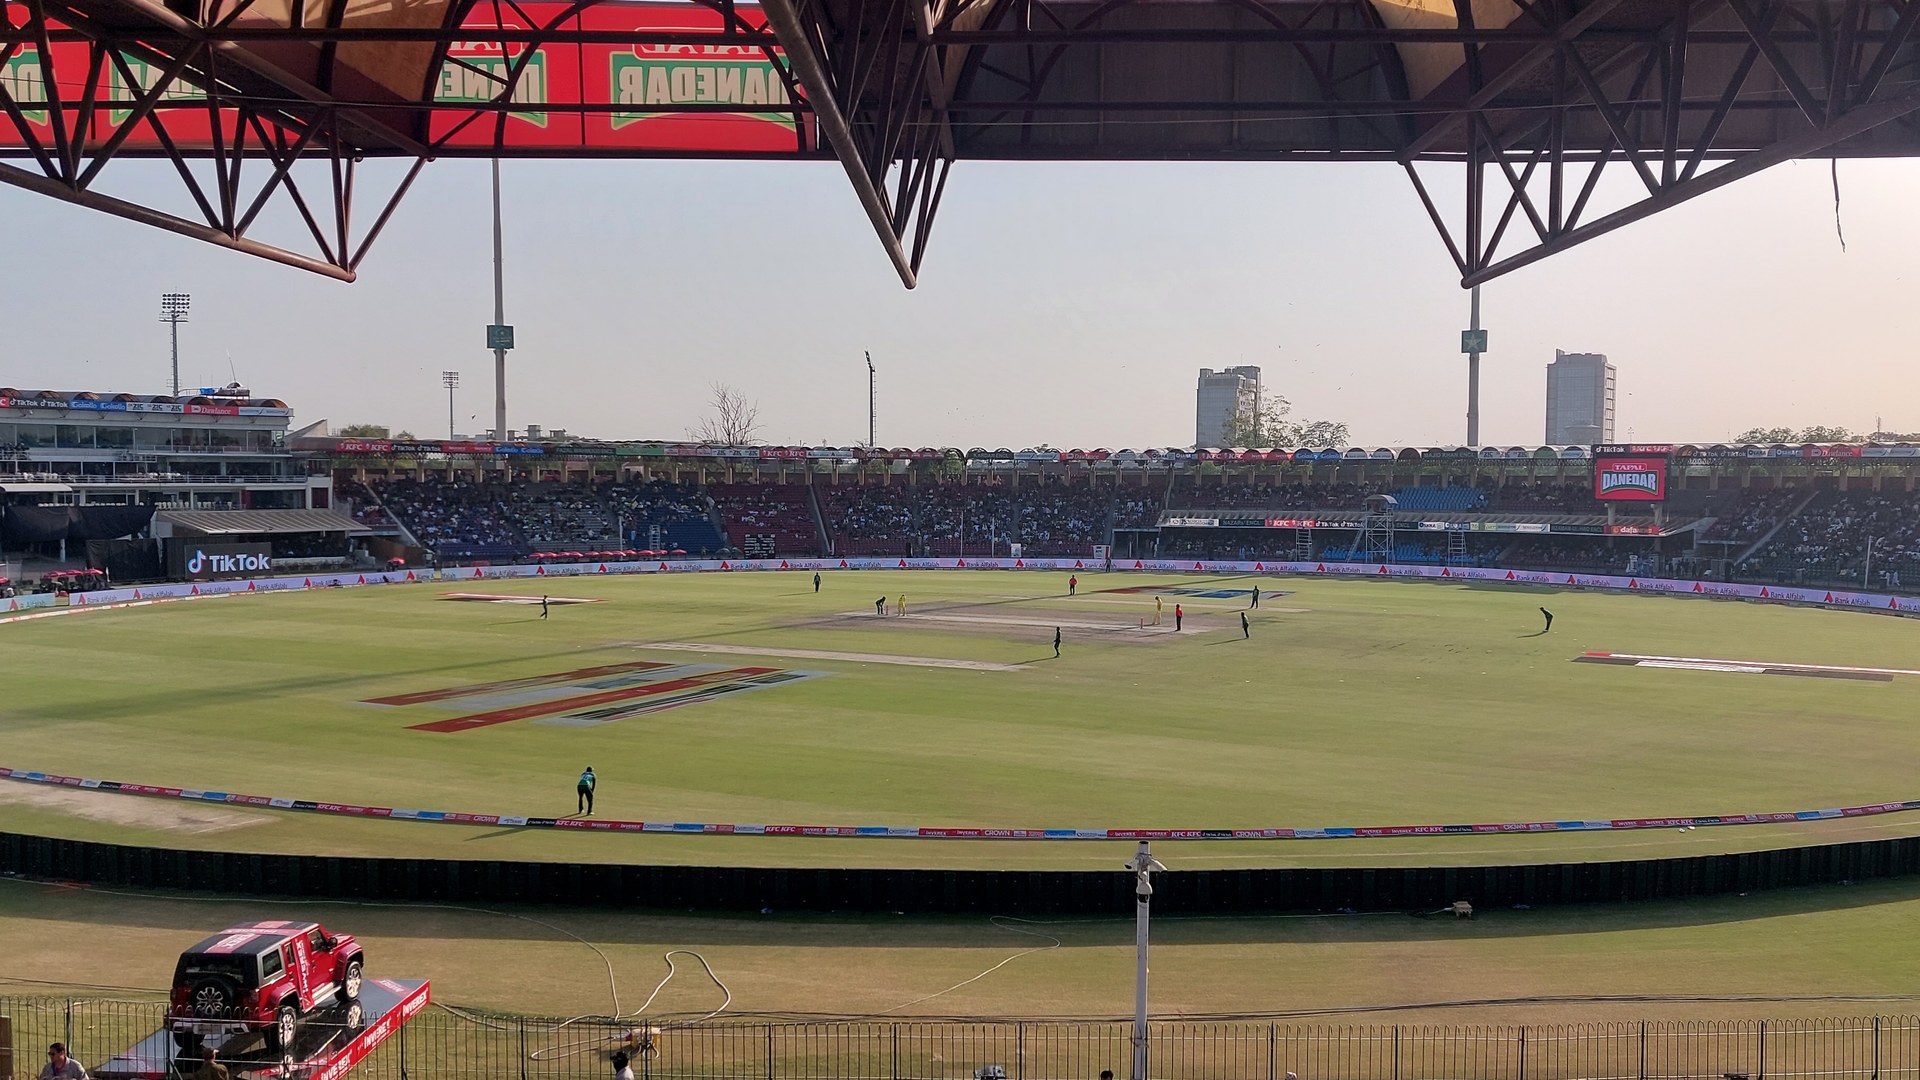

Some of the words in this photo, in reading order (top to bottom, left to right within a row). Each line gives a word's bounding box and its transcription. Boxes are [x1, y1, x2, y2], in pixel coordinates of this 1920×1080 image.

[1602, 473, 1656, 491] DANEDAR
[208, 553, 270, 572] TikTok
[1719, 587, 1740, 595] Alfalah
[1850, 598, 1871, 606] Alfalah
